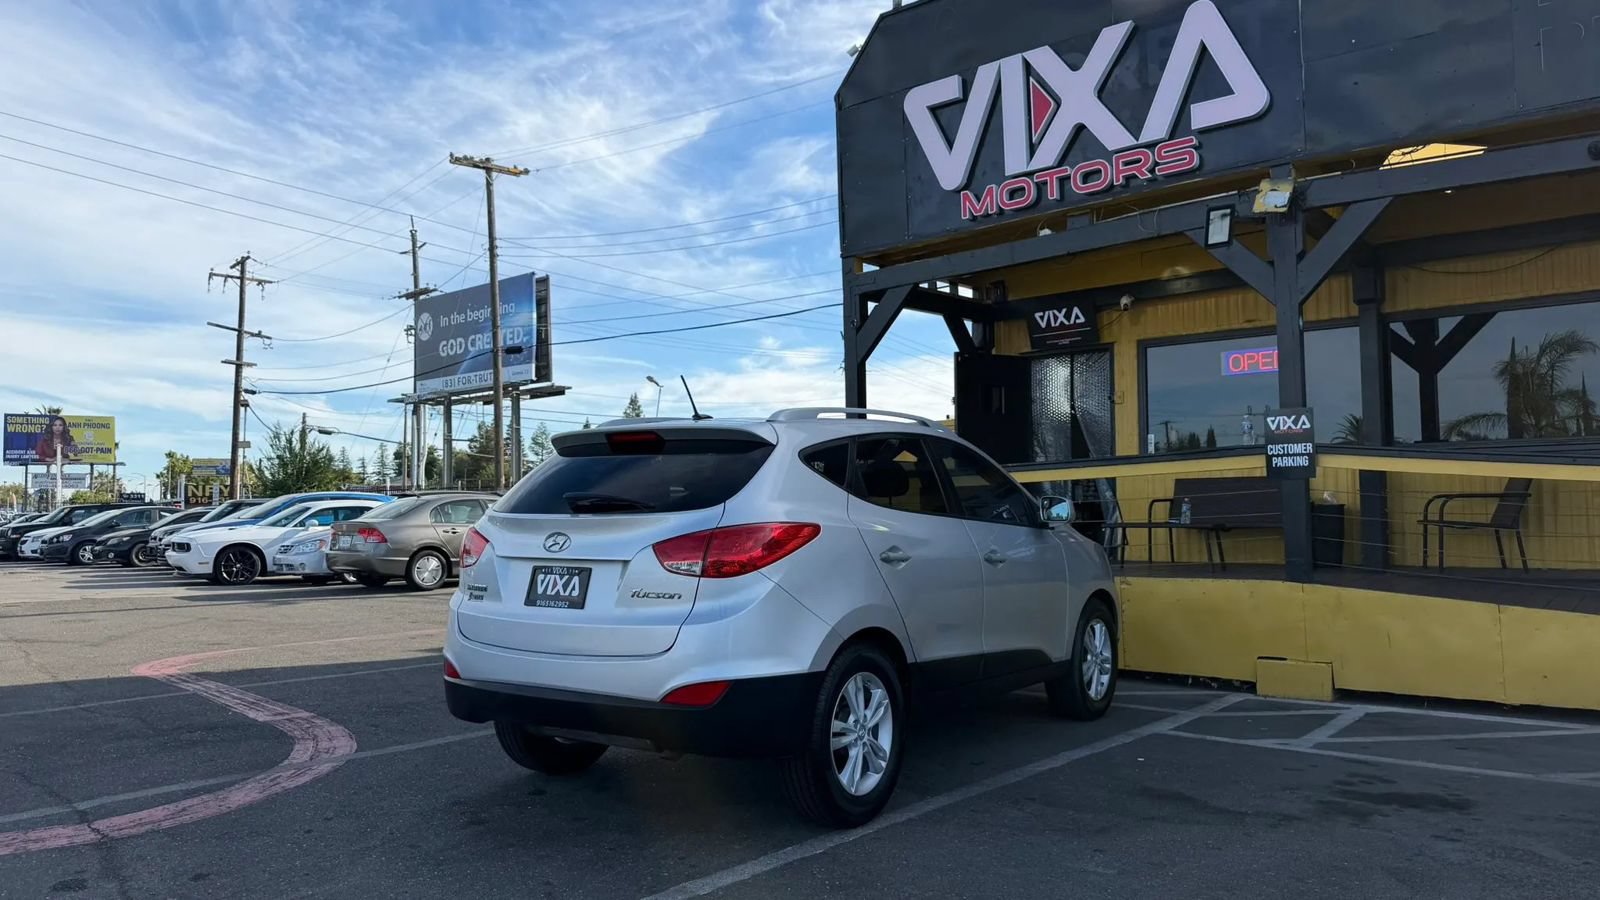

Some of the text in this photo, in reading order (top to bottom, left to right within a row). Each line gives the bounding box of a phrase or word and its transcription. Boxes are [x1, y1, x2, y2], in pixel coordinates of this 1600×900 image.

[904, 0, 1270, 191] VIXA
[960, 136, 1199, 220] MOTORS
[440, 315, 448, 328] In
[451, 312, 466, 325] the
[1034, 306, 1086, 329] VIXA
[439, 338, 465, 357] GOD
[1229, 350, 1278, 371] OPE
[442, 378, 456, 389] (83)
[7, 416, 49, 424] SOMETHING
[1266, 414, 1311, 430] VIXA
[7, 424, 46, 433] WRONG?
[1267, 443, 1313, 455] CUSTOMER
[1272, 456, 1309, 467] PARKING
[537, 574, 580, 597] VIXA
